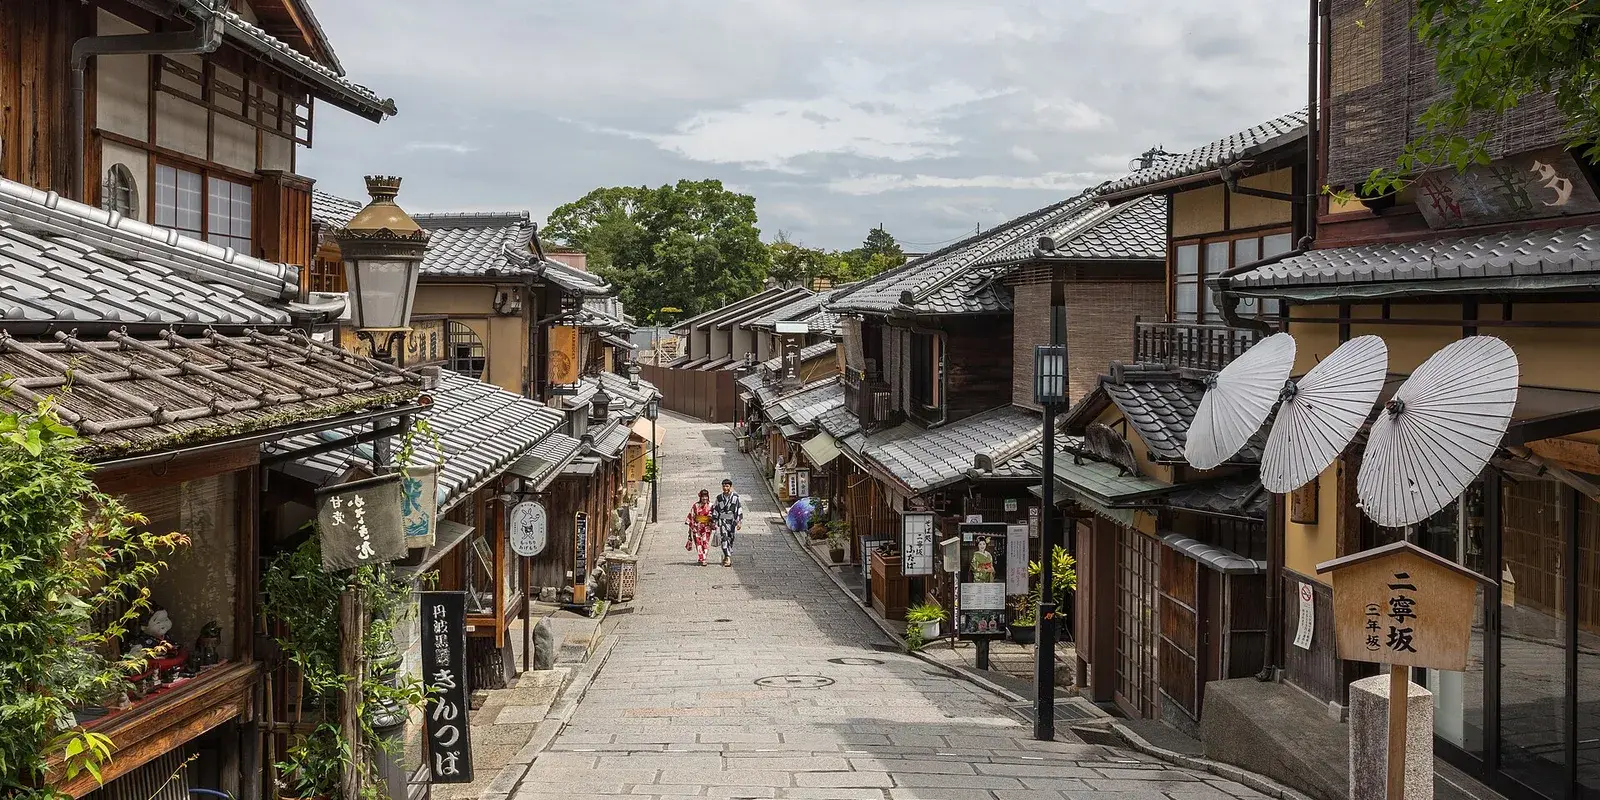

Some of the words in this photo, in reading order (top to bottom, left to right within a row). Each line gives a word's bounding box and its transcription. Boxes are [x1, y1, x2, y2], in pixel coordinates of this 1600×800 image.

[785, 338, 798, 379] 二井三
[906, 544, 916, 569] ふたば
[433, 604, 450, 666] 丹波黒
[1386, 572, 1417, 653] 二寧坂
[432, 669, 460, 776] きんつば
